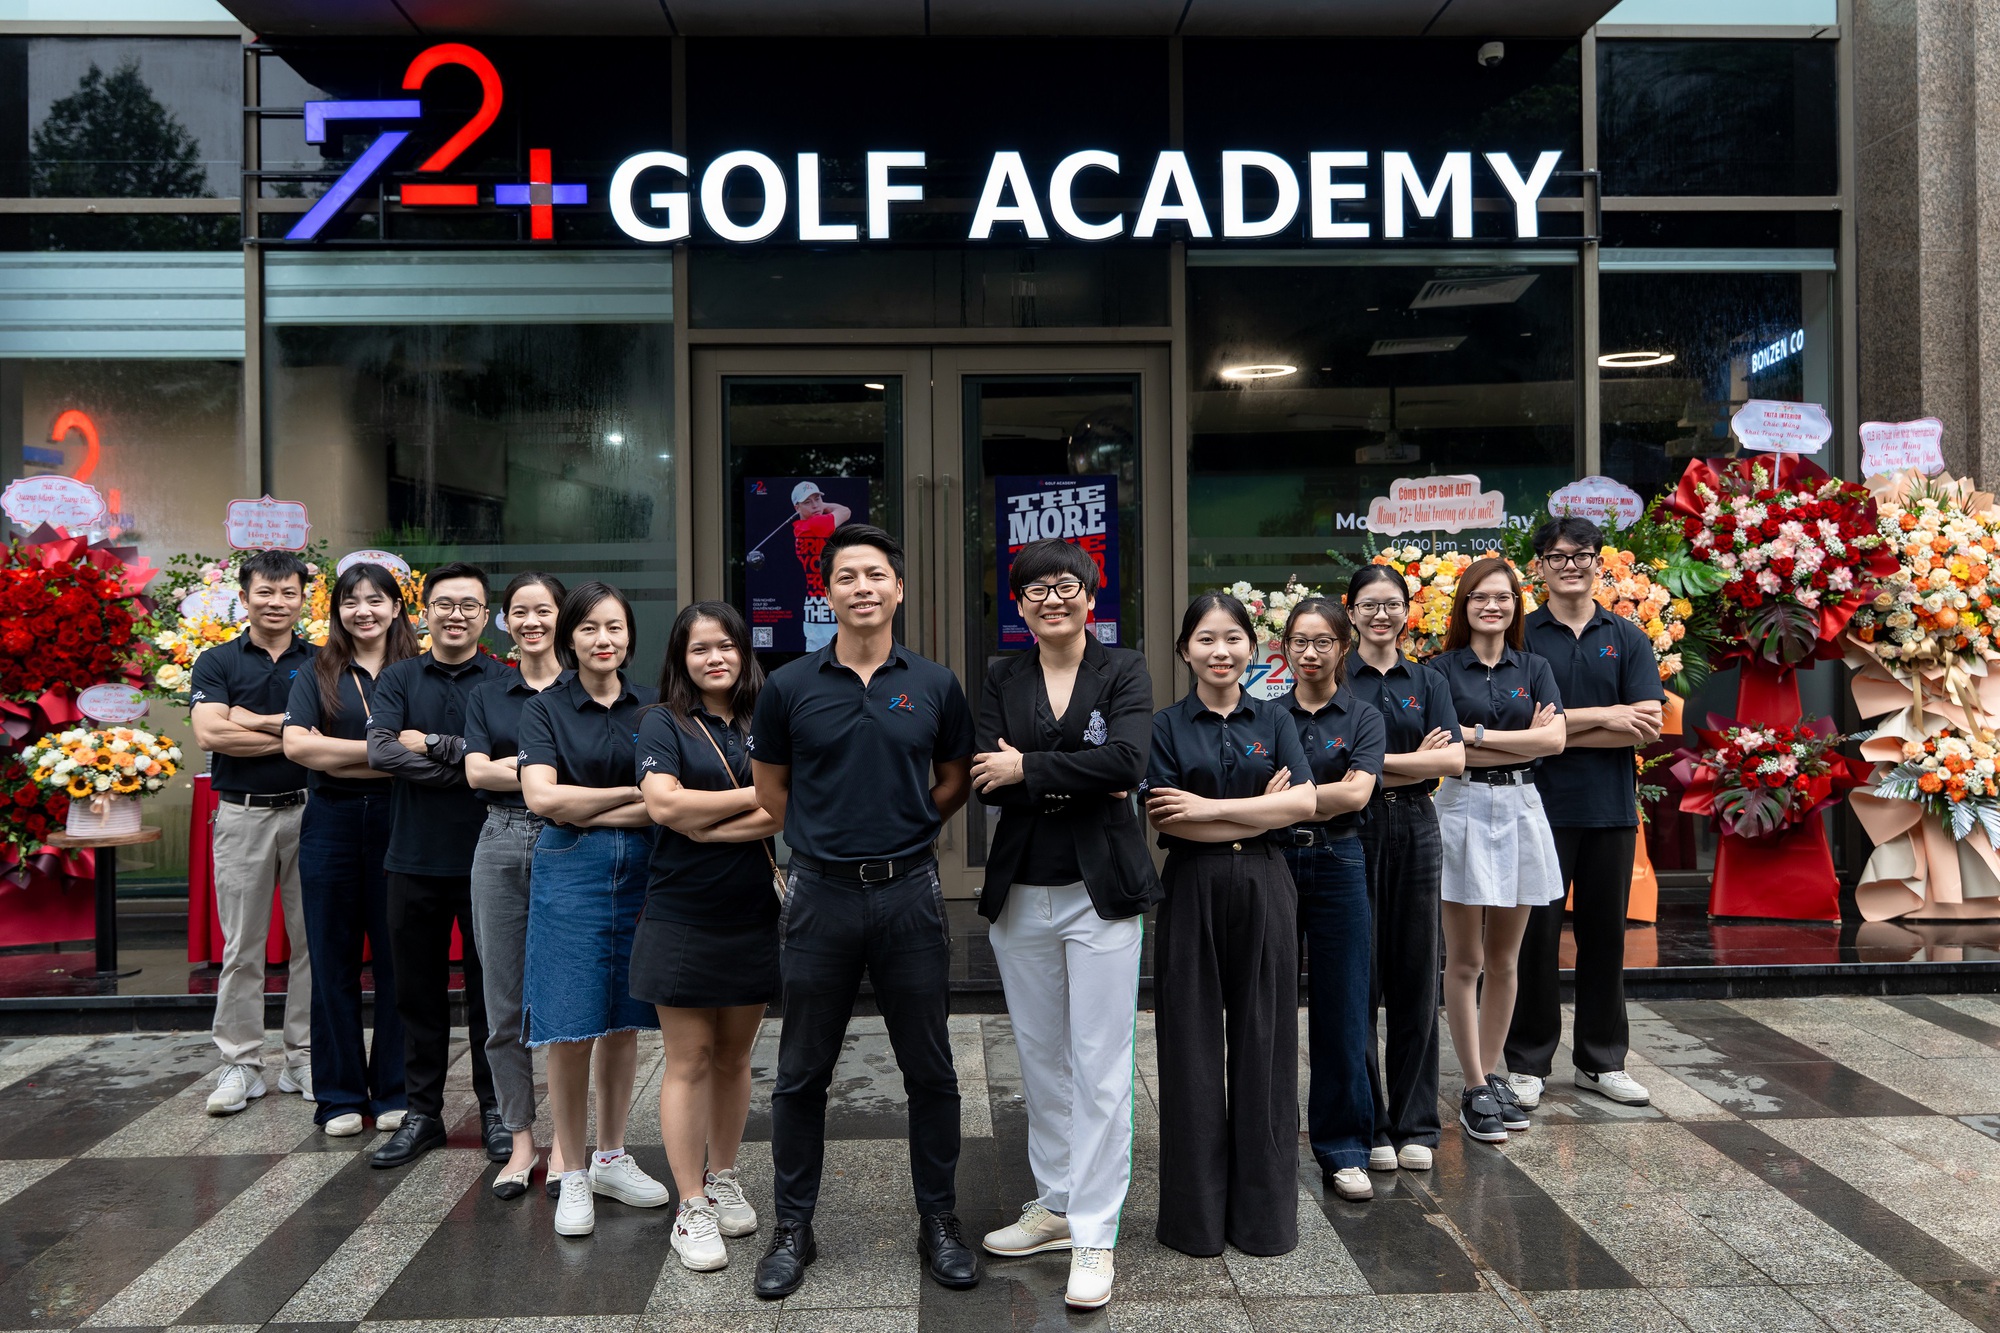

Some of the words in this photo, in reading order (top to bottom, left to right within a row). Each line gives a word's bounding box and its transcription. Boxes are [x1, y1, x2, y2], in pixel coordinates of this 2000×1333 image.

[284, 43, 588, 240] 72+
[608, 149, 927, 243] GOLF
[966, 149, 1563, 242] ACADEMY
[1752, 336, 1788, 374] BONZEN
[1790, 328, 1804, 354] CO
[1007, 484, 1105, 512] THE
[1398, 486, 1417, 501] Công
[1418, 487, 1426, 500] ty
[1427, 485, 1438, 499] CP
[1439, 483, 1454, 498] Golf
[1455, 482, 1472, 497] 4477
[1414, 504, 1431, 523] khai
[1008, 501, 1106, 546] MORE
[1434, 542, 1457, 551] am
[1599, 645, 1618, 659] 72+
[888, 693, 915, 711] 72+
[1511, 687, 1530, 699] 72+
[1402, 696, 1421, 710] 72+
[1246, 742, 1269, 757] 72+
[1325, 737, 1347, 749] 72+
